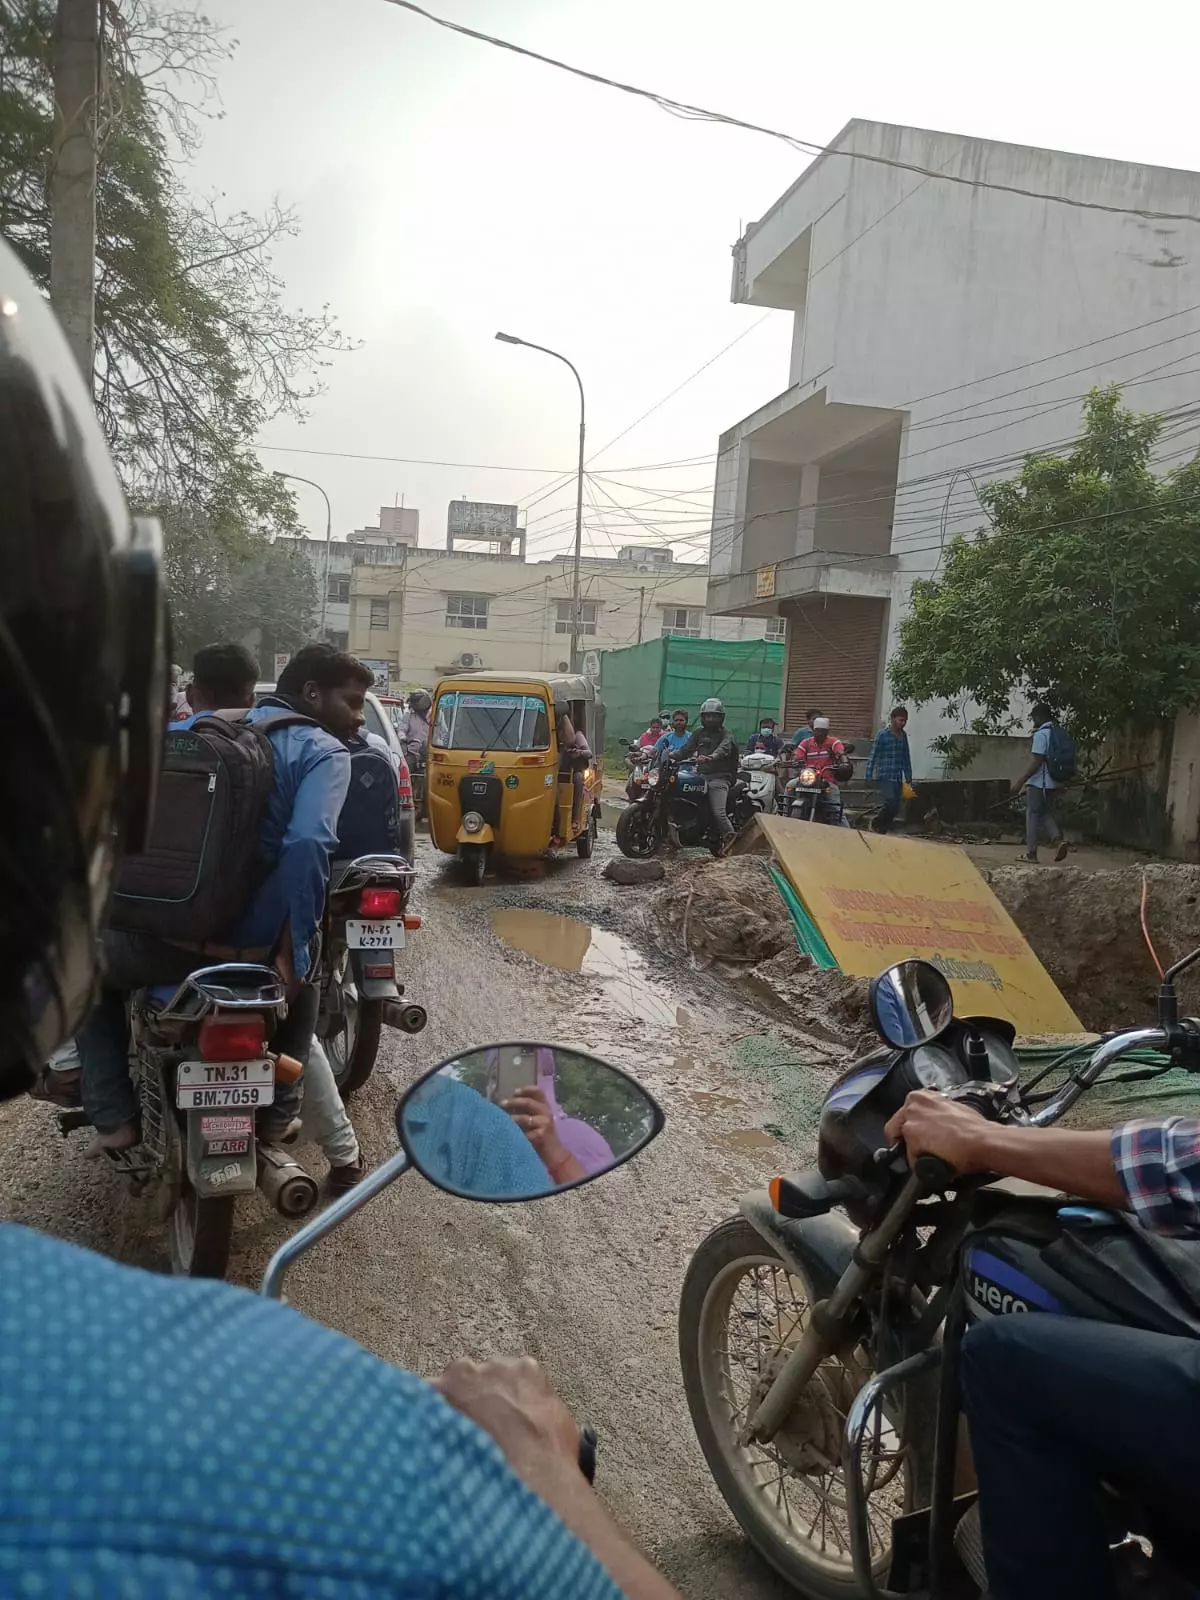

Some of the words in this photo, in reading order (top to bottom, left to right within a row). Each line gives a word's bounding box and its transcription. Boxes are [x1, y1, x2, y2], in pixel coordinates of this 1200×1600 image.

[204, 1066, 249, 1082] TN.31
[192, 1088, 260, 1106] BM.7059
[974, 1277, 1029, 1314] Hero
